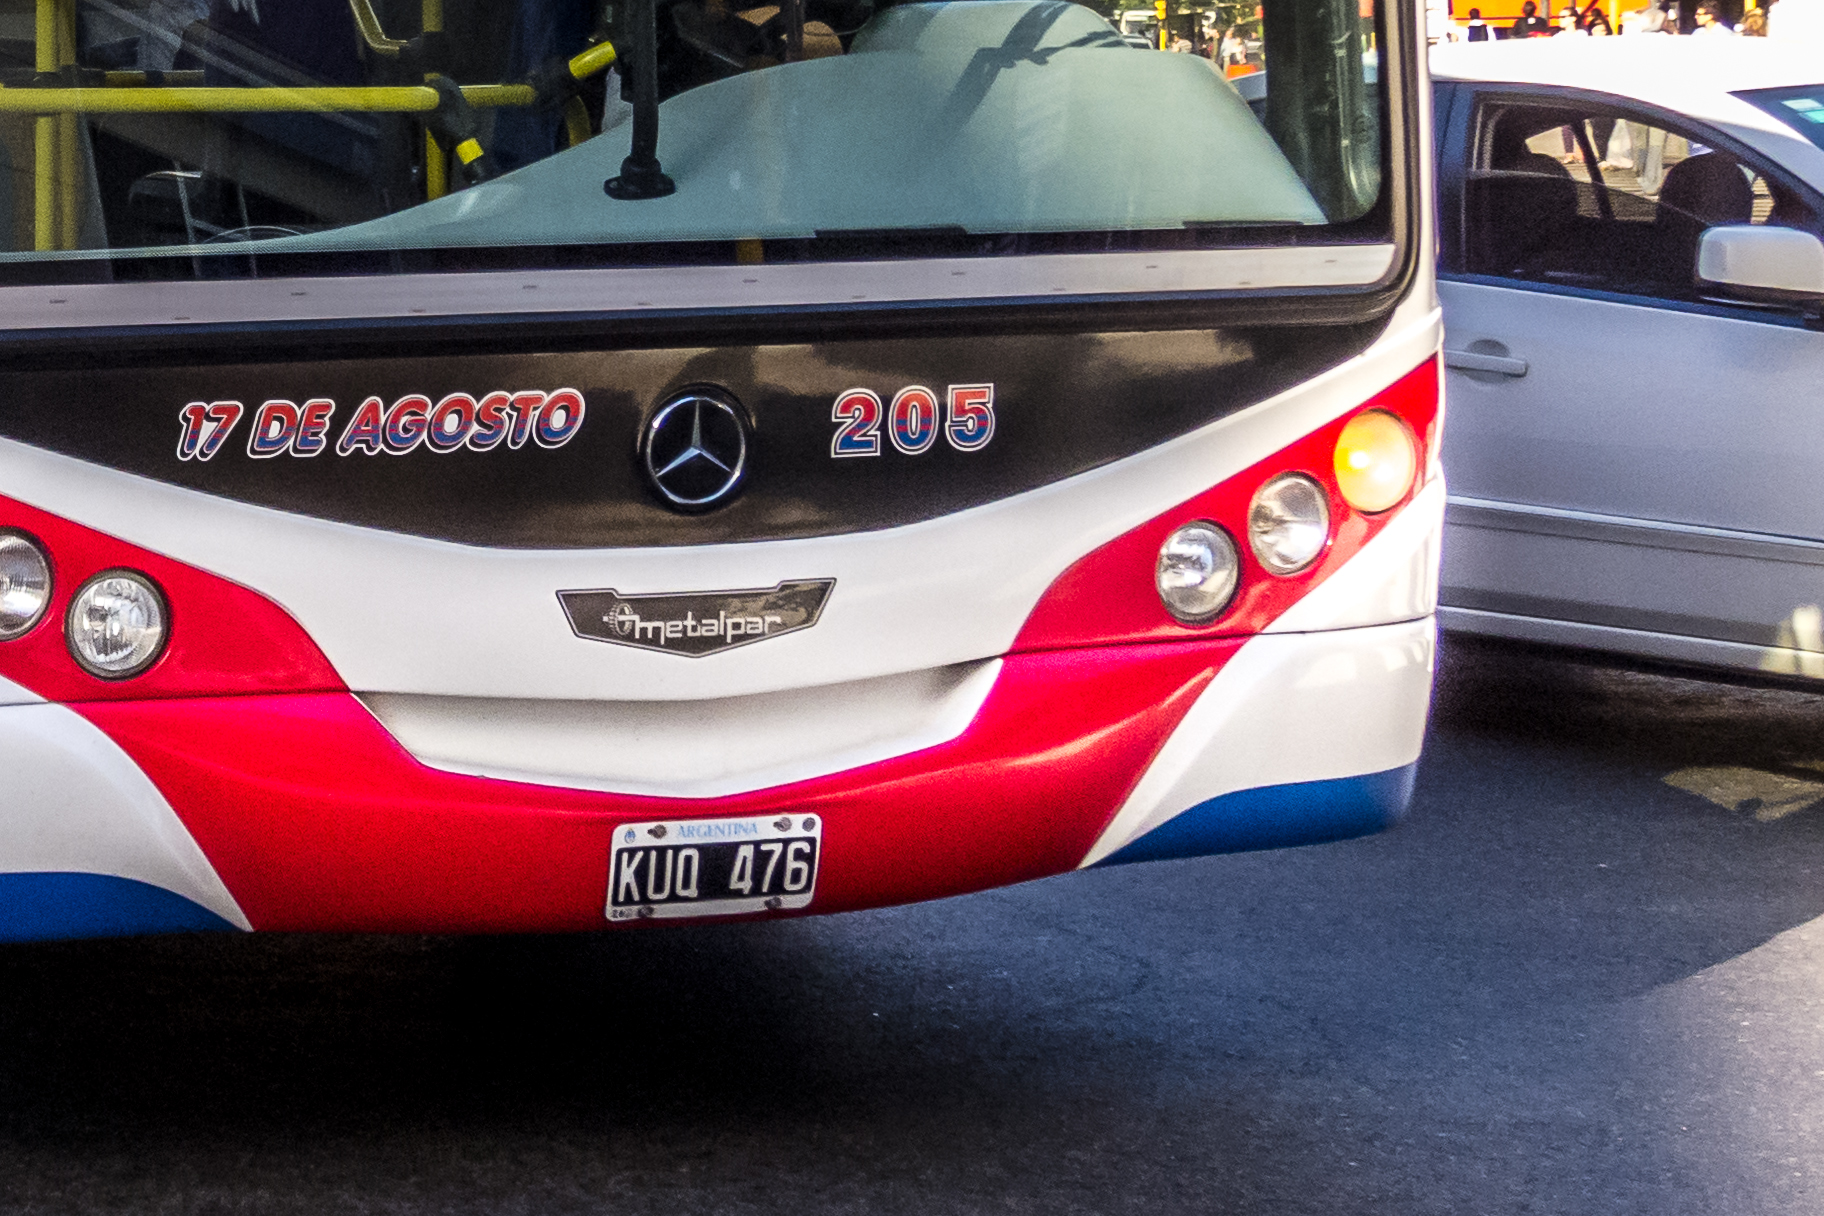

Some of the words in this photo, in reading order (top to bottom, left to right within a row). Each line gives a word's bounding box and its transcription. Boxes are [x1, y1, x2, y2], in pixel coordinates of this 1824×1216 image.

[176, 400, 243, 462] 17
[247, 397, 333, 460] DE
[337, 388, 586, 458] AGOSTO
[829, 383, 995, 458] 205
[624, 610, 782, 645] metalpar
[677, 821, 758, 839] ARGENTINA
[617, 847, 700, 903] KUQ
[728, 840, 811, 895] 476
